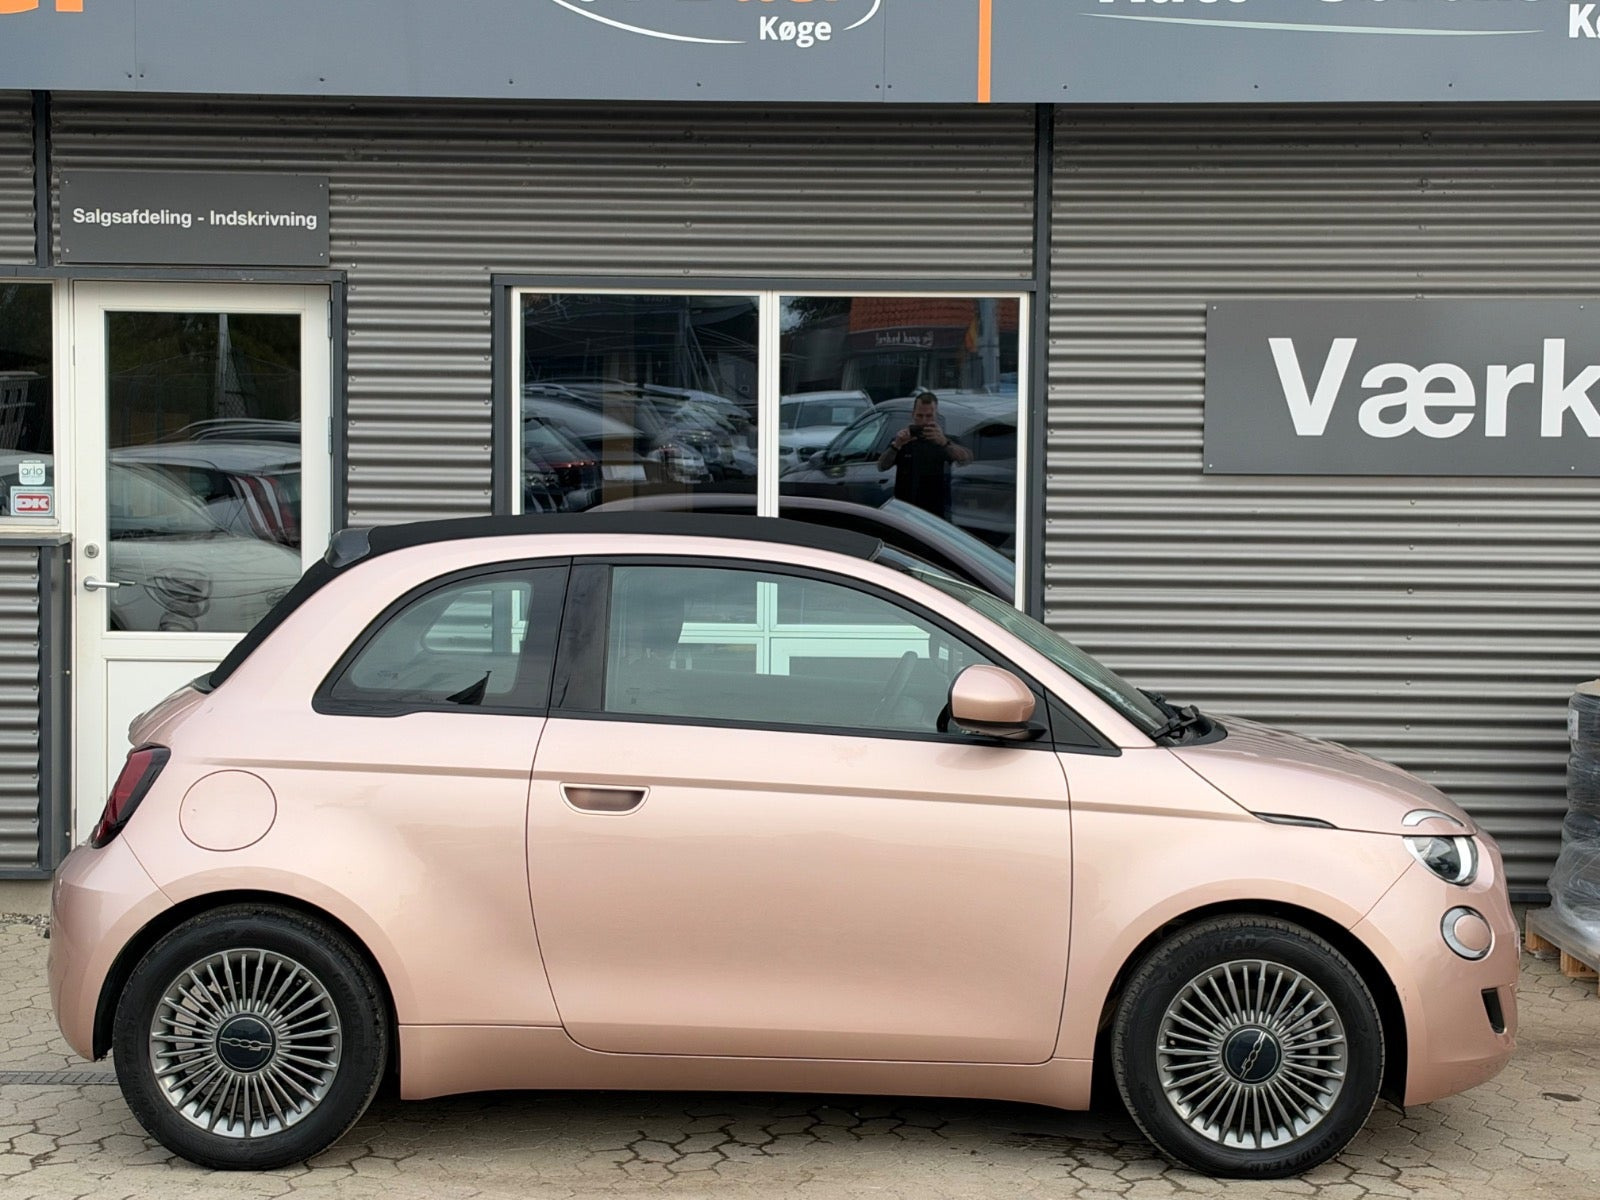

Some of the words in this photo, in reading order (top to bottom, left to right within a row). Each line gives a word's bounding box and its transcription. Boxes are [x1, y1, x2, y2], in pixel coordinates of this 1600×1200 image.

[759, 16, 831, 48] Køge
[72, 207, 192, 228] Salgsafdeling
[209, 209, 318, 230] Indskrivning
[1268, 337, 1600, 439] Værk
[15, 496, 50, 511] DK
